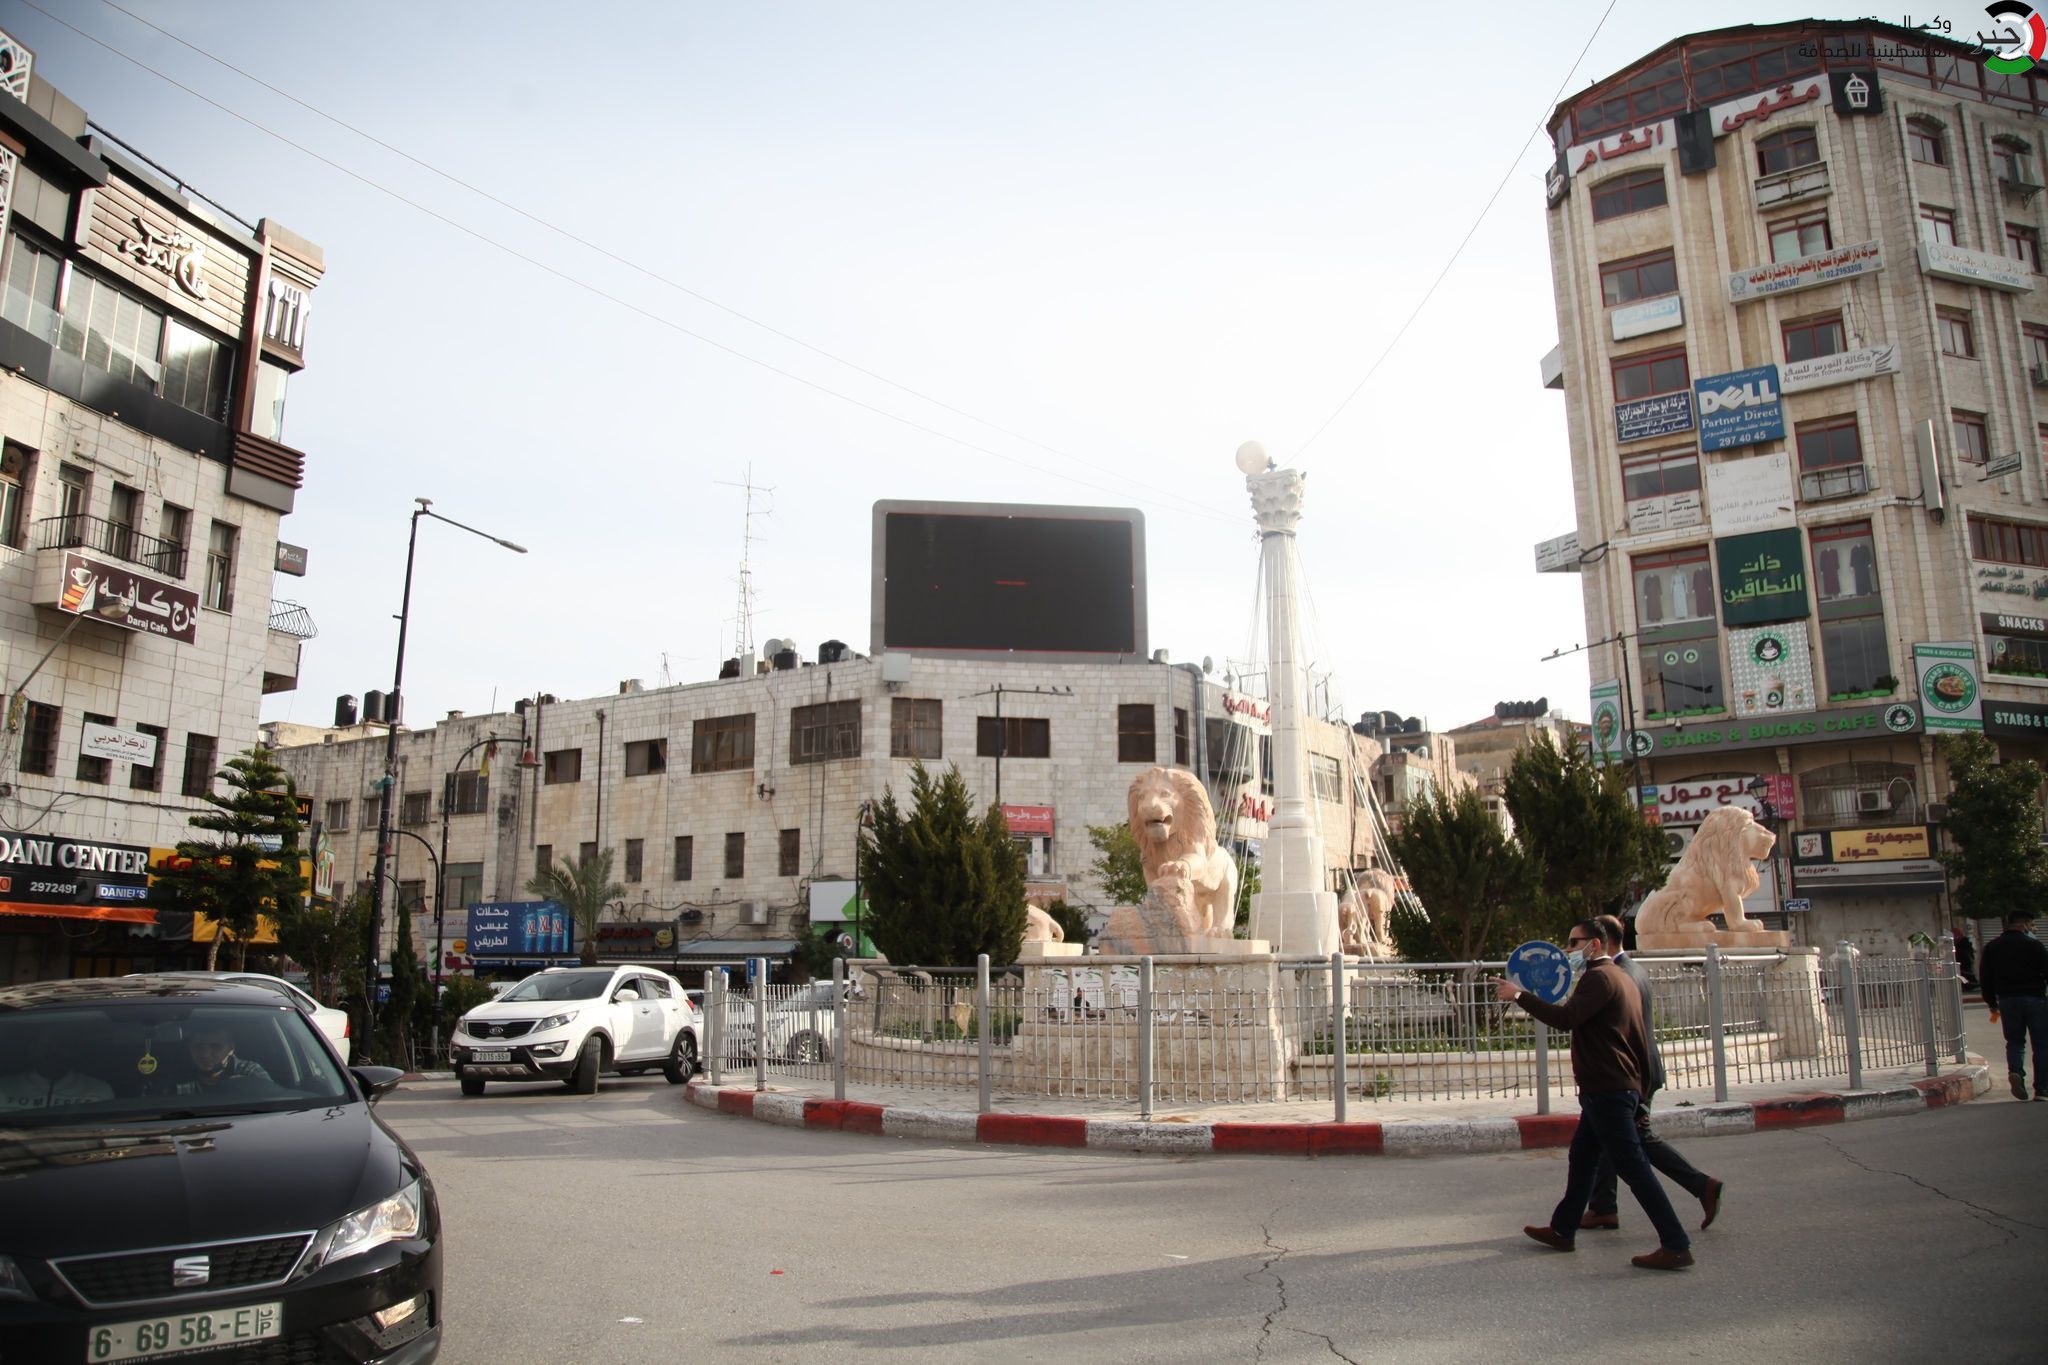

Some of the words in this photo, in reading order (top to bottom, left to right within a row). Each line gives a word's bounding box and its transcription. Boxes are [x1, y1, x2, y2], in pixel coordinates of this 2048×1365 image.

[1722, 83, 1820, 132] مقهى
[1577, 123, 1662, 173] الشام
[1813, 357, 1843, 371] النورس
[1844, 354, 1871, 365] وكالة
[1793, 372, 1819, 383] Nawras
[1821, 367, 1843, 377] Travel
[1844, 361, 1872, 373] Agency
[1669, 397, 1686, 409] شركة
[1698, 379, 1777, 415] DELL
[1702, 414, 1741, 429] Partner
[1744, 408, 1779, 421] Direct
[1719, 436, 1736, 447] 297
[1739, 434, 1751, 443] 40
[1754, 430, 1766, 441] 45
[1739, 553, 1781, 574] ذات
[1723, 573, 1802, 603] النطاقين
[99, 576, 172, 618] كافيه
[127, 614, 149, 631] Daraj
[150, 621, 168, 634] Cafe
[171, 601, 198, 632] درج
[1998, 615, 2045, 631] SNACKS
[1995, 712, 2031, 727] STARS
[2033, 715, 2041, 728] &
[94, 734, 122, 745] العربي
[1660, 729, 1722, 749] STARS
[1728, 727, 1742, 741] &
[1748, 718, 1817, 740] BUCKS
[122, 735, 148, 751] المركز
[1660, 784, 1712, 805] مول
[58, 843, 149, 876] CENTER
[1840, 847, 1879, 859] حواء
[30, 881, 77, 895] 2972491
[476, 906, 509, 917] محلات
[475, 922, 509, 932] عيسى
[527, 920, 537, 934] XL
[539, 915, 551, 932] XL
[553, 919, 563, 934] XL
[474, 935, 508, 951] الطريفي
[260, 1321, 272, 1336] P
